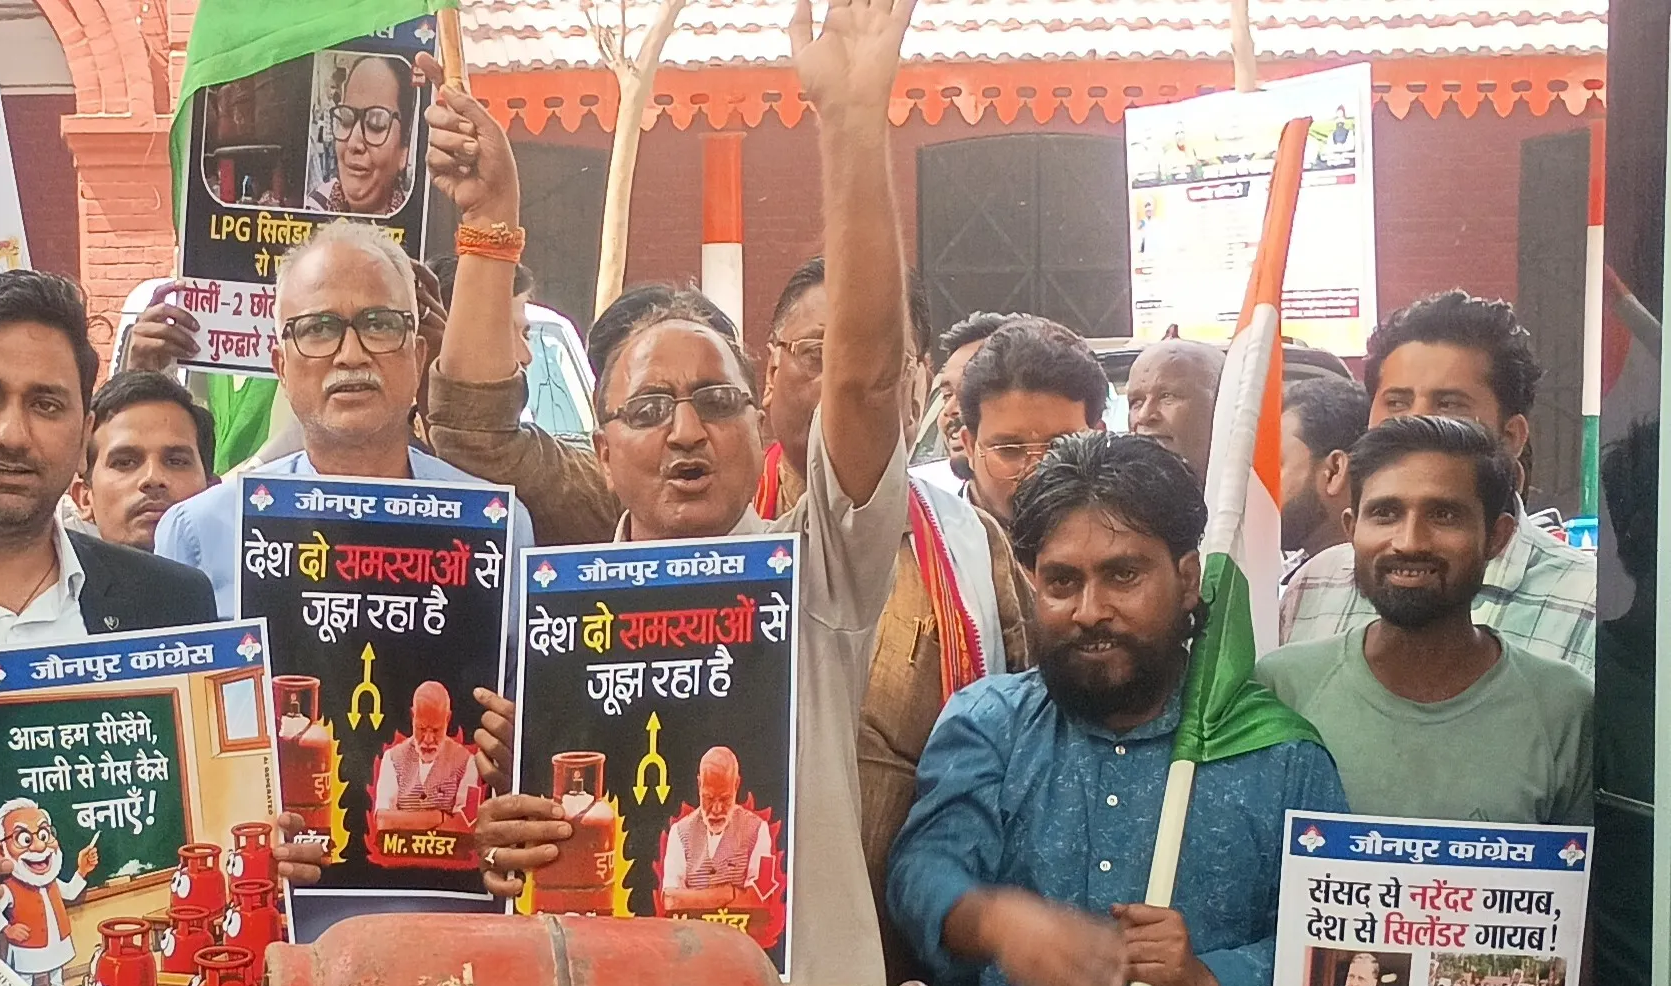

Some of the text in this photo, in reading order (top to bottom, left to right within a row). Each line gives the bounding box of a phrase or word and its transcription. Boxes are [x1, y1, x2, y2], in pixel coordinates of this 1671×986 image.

[210, 214, 252, 242] LPG
[256, 212, 312, 245] सिलेंडर
[255, 249, 271, 277] रो
[295, 488, 462, 519] जौनपुर कांग्रेस
[245, 528, 504, 589] देश दो समस्याओं से
[578, 551, 745, 586] जौनपुर कांग्रेस
[301, 585, 449, 643] जूझ रहा है
[529, 591, 790, 656] देश दो समस्याओं से
[30, 642, 214, 680] जौनपुर कांग्रेस
[586, 644, 734, 716] जूझ रहा है
[8, 725, 54, 751] आज
[58, 722, 89, 750] हम
[17, 749, 169, 793] नाली से गैस कैसे
[383, 830, 457, 855] Mr. सरेंडर
[1349, 831, 1535, 863] जौनपुर कांग्रेस
[1308, 873, 1561, 921] संसद से नरेंदर गायब,
[1306, 907, 1558, 951] देश से सिलेंडर गायब!
